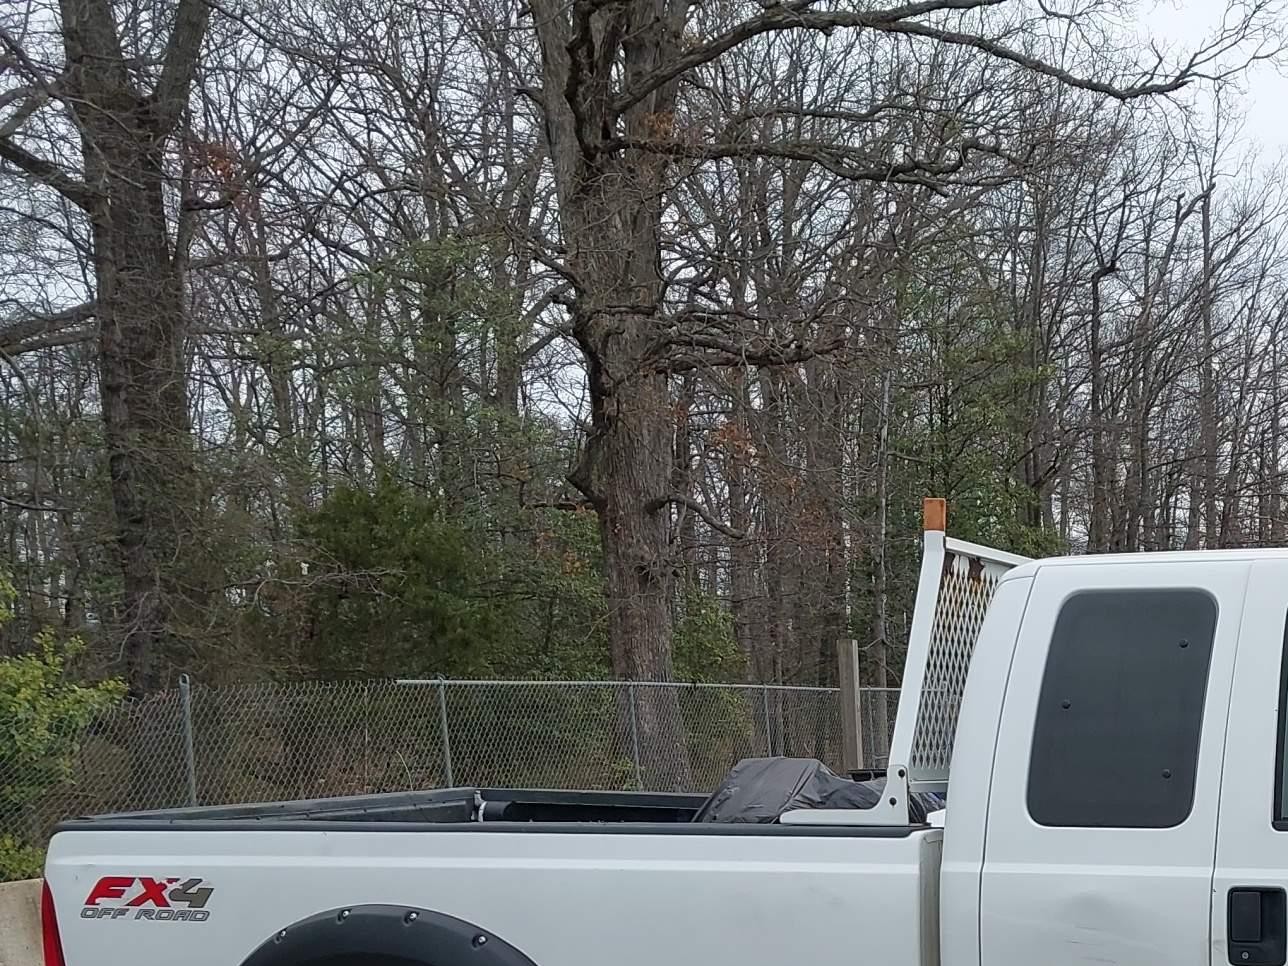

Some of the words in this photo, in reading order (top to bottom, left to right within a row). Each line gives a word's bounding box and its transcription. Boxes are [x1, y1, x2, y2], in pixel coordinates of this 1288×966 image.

[84, 876, 215, 909] FX4
[80, 907, 130, 919] OFF
[134, 908, 211, 922] ROAD
